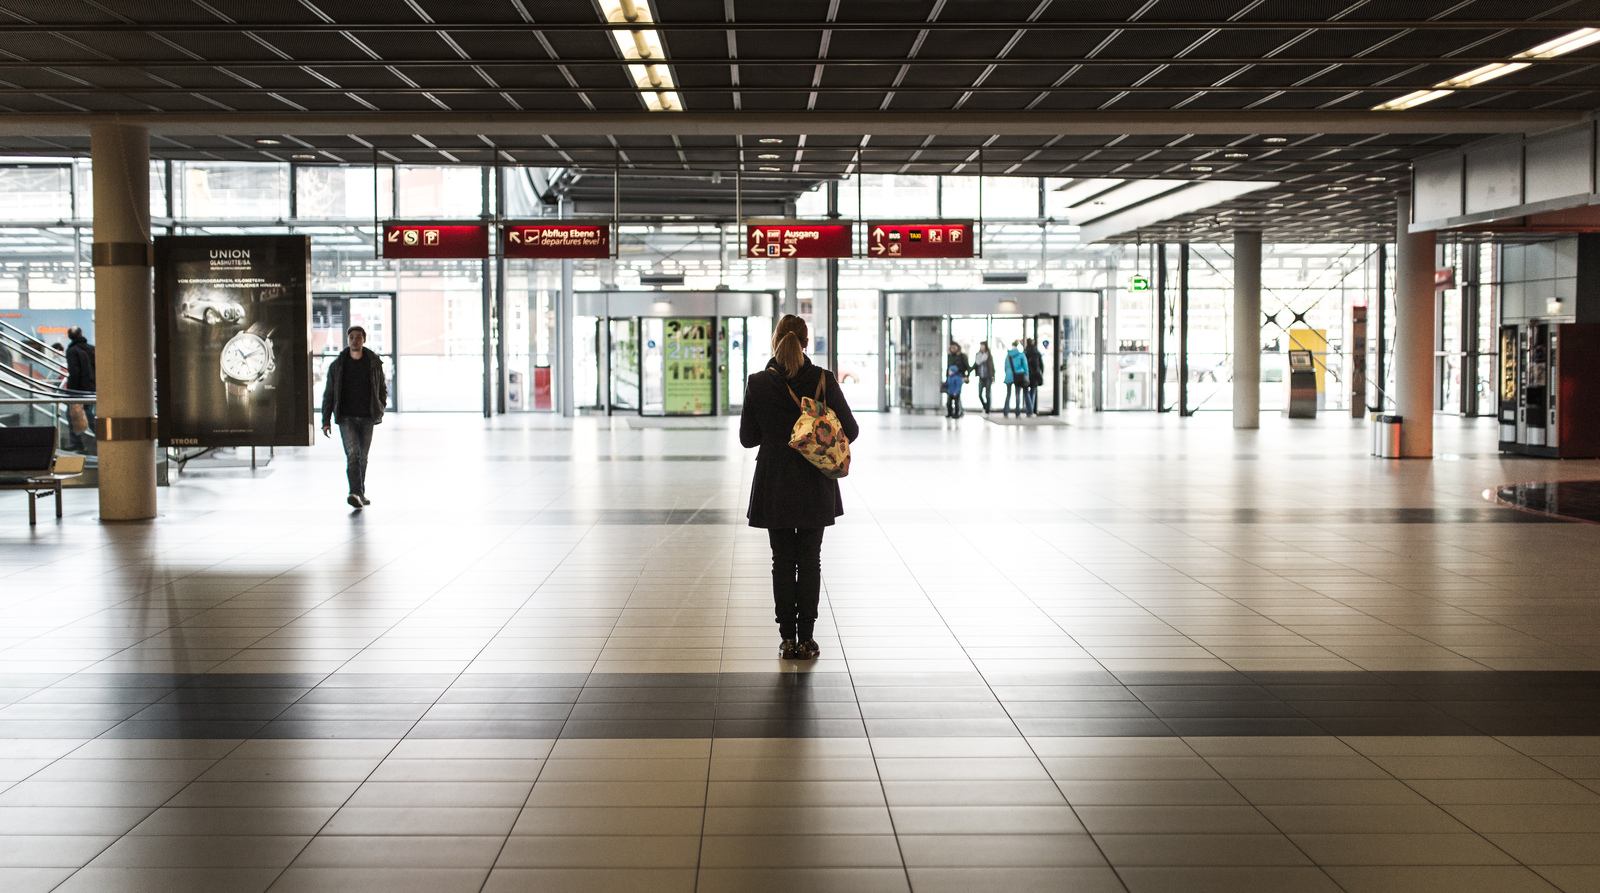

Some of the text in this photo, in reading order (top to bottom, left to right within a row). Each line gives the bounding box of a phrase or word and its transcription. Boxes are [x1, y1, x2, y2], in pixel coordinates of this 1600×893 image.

[541, 229, 569, 239] Abflug
[570, 229, 595, 238] Ebene
[784, 229, 820, 240] Ausgang
[541, 238, 582, 247] departures
[583, 237, 600, 246] level
[209, 249, 251, 259] UNION
